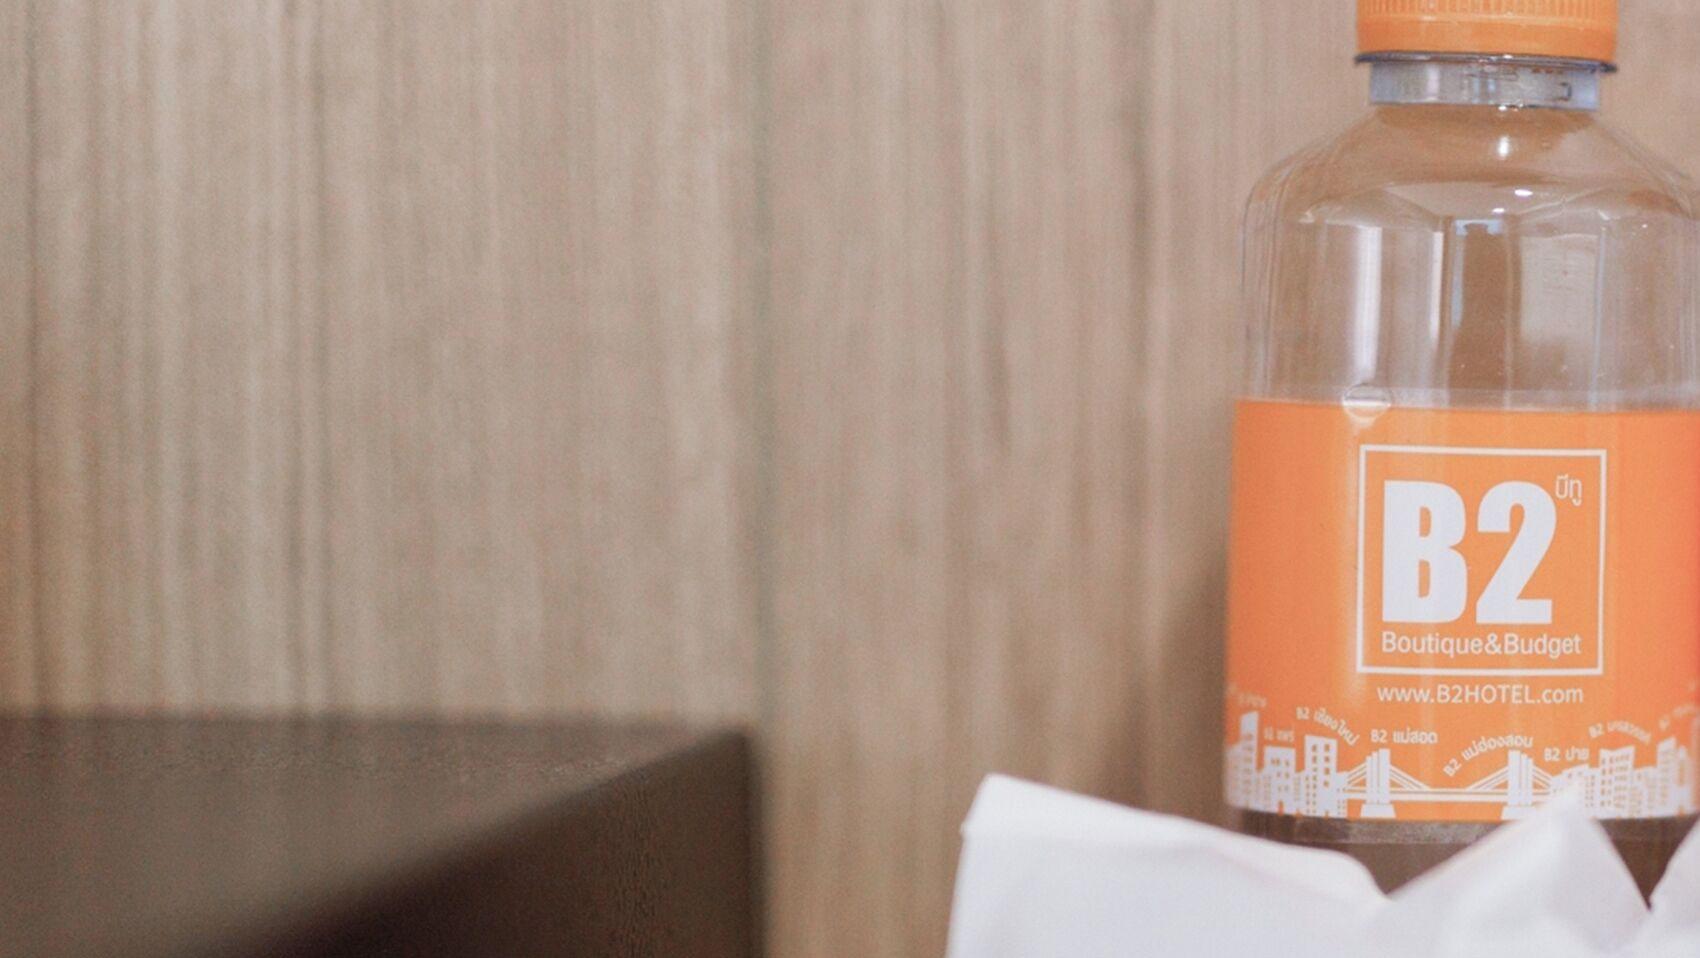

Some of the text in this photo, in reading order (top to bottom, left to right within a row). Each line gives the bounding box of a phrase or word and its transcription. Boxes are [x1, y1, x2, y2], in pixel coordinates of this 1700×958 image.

[1555, 474, 1582, 506] บีทู
[1382, 480, 1557, 624] B2
[1382, 631, 1582, 658] Boutique&Budget
[1377, 684, 1584, 705] www.B2HOTEL.com
[1370, 729, 1387, 743] B2
[1543, 748, 1560, 761] B2
[1443, 758, 1462, 777] B2
